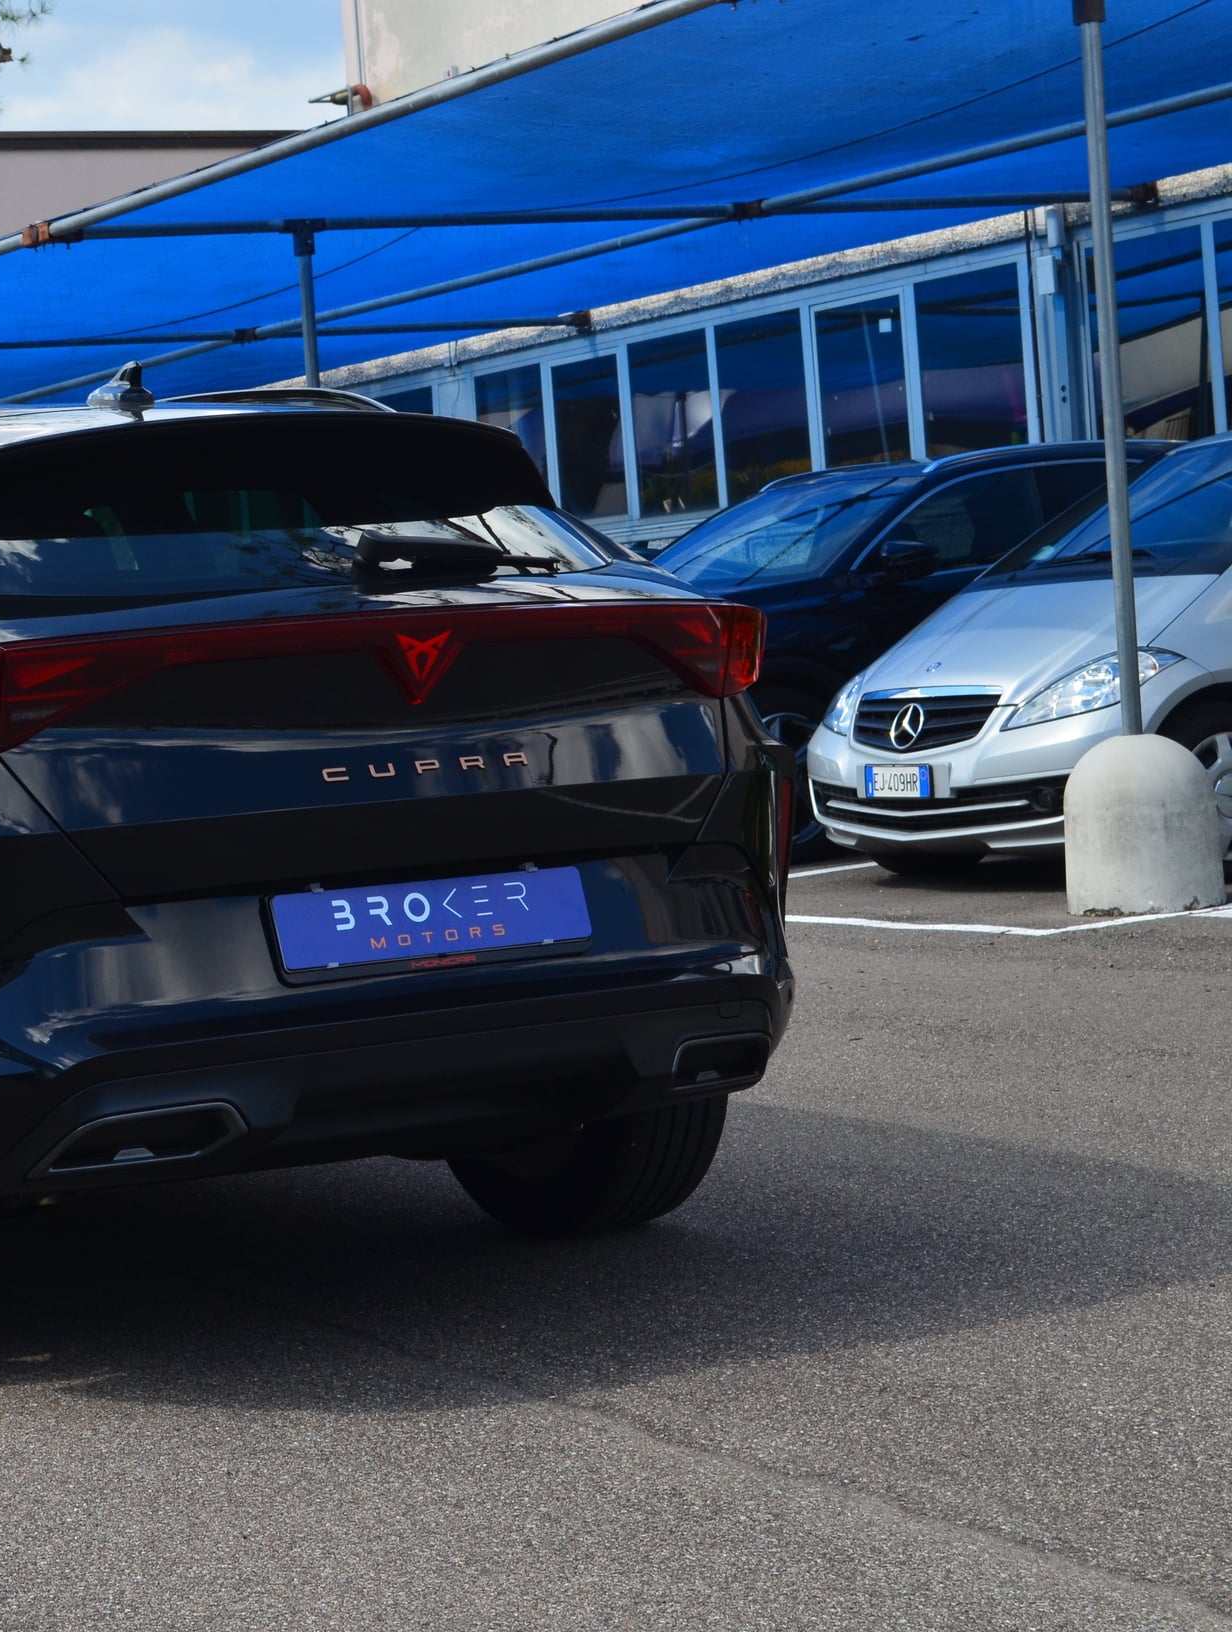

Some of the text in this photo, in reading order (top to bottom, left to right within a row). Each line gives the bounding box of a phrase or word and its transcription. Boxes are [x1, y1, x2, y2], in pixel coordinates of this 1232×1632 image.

[321, 751, 529, 783] CUPRA
[331, 881, 530, 931] BROKER
[370, 923, 506, 949] MOTORS
